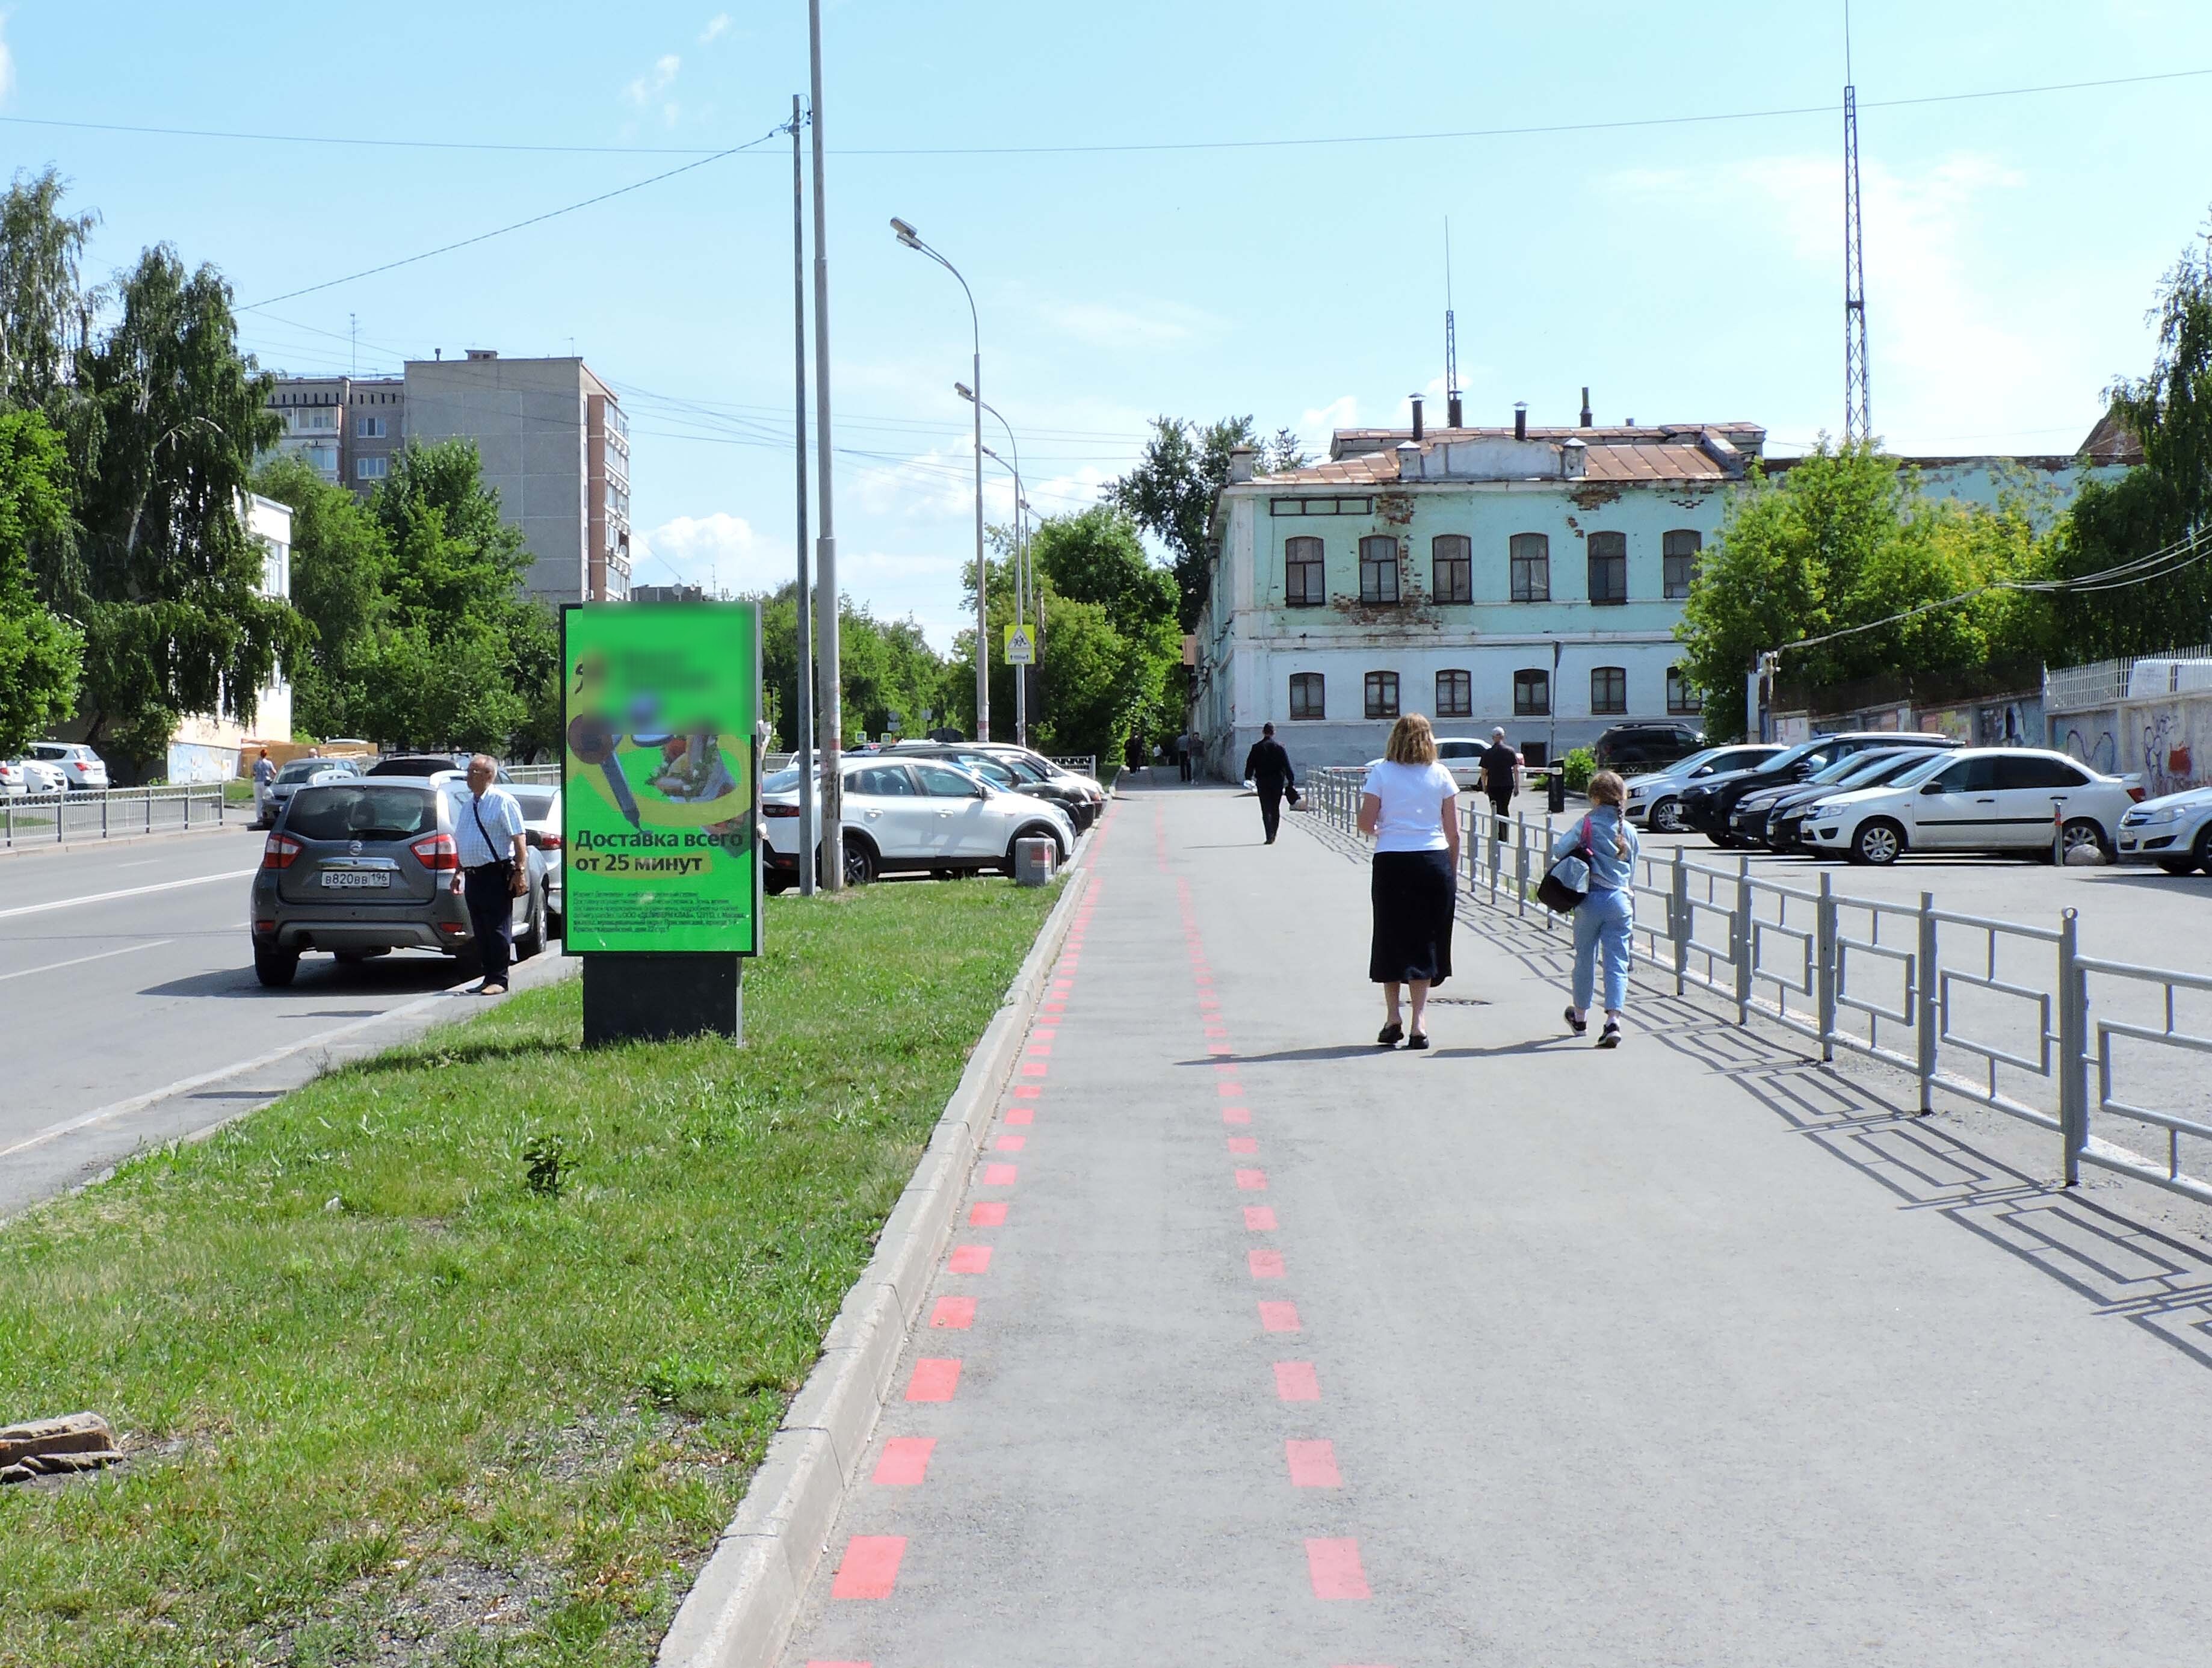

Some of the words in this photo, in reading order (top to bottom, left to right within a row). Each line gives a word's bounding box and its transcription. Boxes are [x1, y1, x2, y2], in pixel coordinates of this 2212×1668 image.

[575, 830, 679, 851] Доставка
[684, 833, 743, 847] всего
[575, 857, 600, 871] от
[605, 854, 629, 871] 25
[635, 857, 703, 875] минут
[326, 874, 368, 885] В820ВВ
[371, 873, 387, 882] 196
